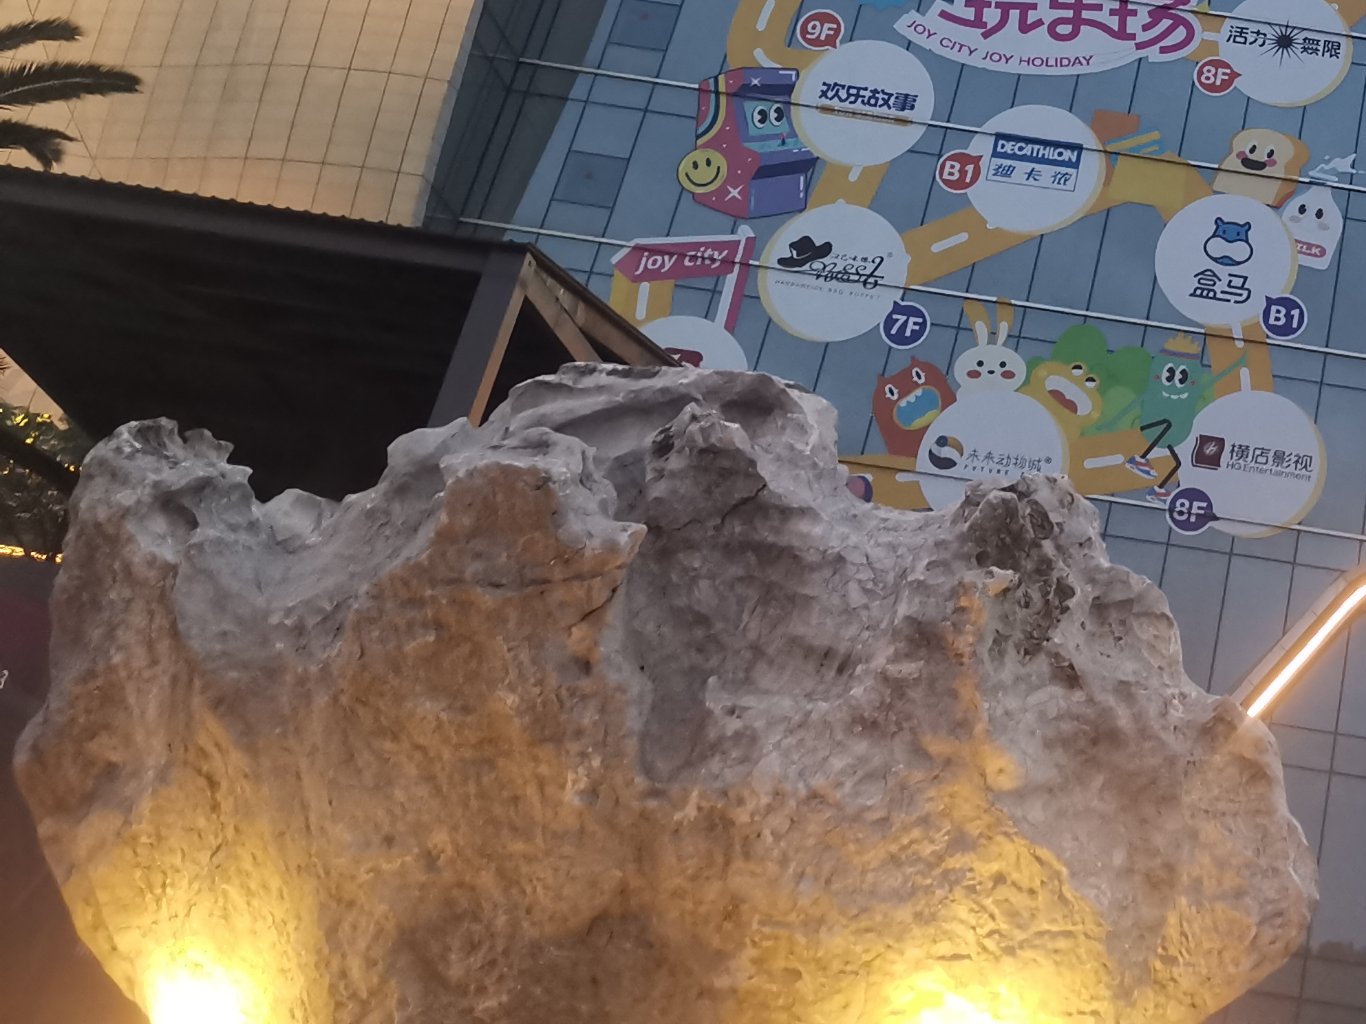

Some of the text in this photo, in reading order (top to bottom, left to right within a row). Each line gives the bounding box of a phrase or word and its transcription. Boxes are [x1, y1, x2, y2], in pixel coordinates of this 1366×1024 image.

[806, 21, 837, 40] 9F
[907, 20, 1094, 68] JOY CITY JOY HOLIDAY
[1201, 66, 1230, 85] 8F
[819, 82, 918, 111] 欢乐故事
[997, 140, 1077, 163] DECATHLON
[943, 161, 975, 183] B1
[992, 164, 1072, 186] 迪卡侬
[634, 247, 728, 275] joy city
[1189, 269, 1251, 304] 盒马
[892, 314, 923, 337] 7F
[1269, 305, 1300, 328] B1
[1229, 443, 1314, 472] 横店影视
[1243, 465, 1312, 482] Entertainment
[1173, 499, 1208, 522] 8F
